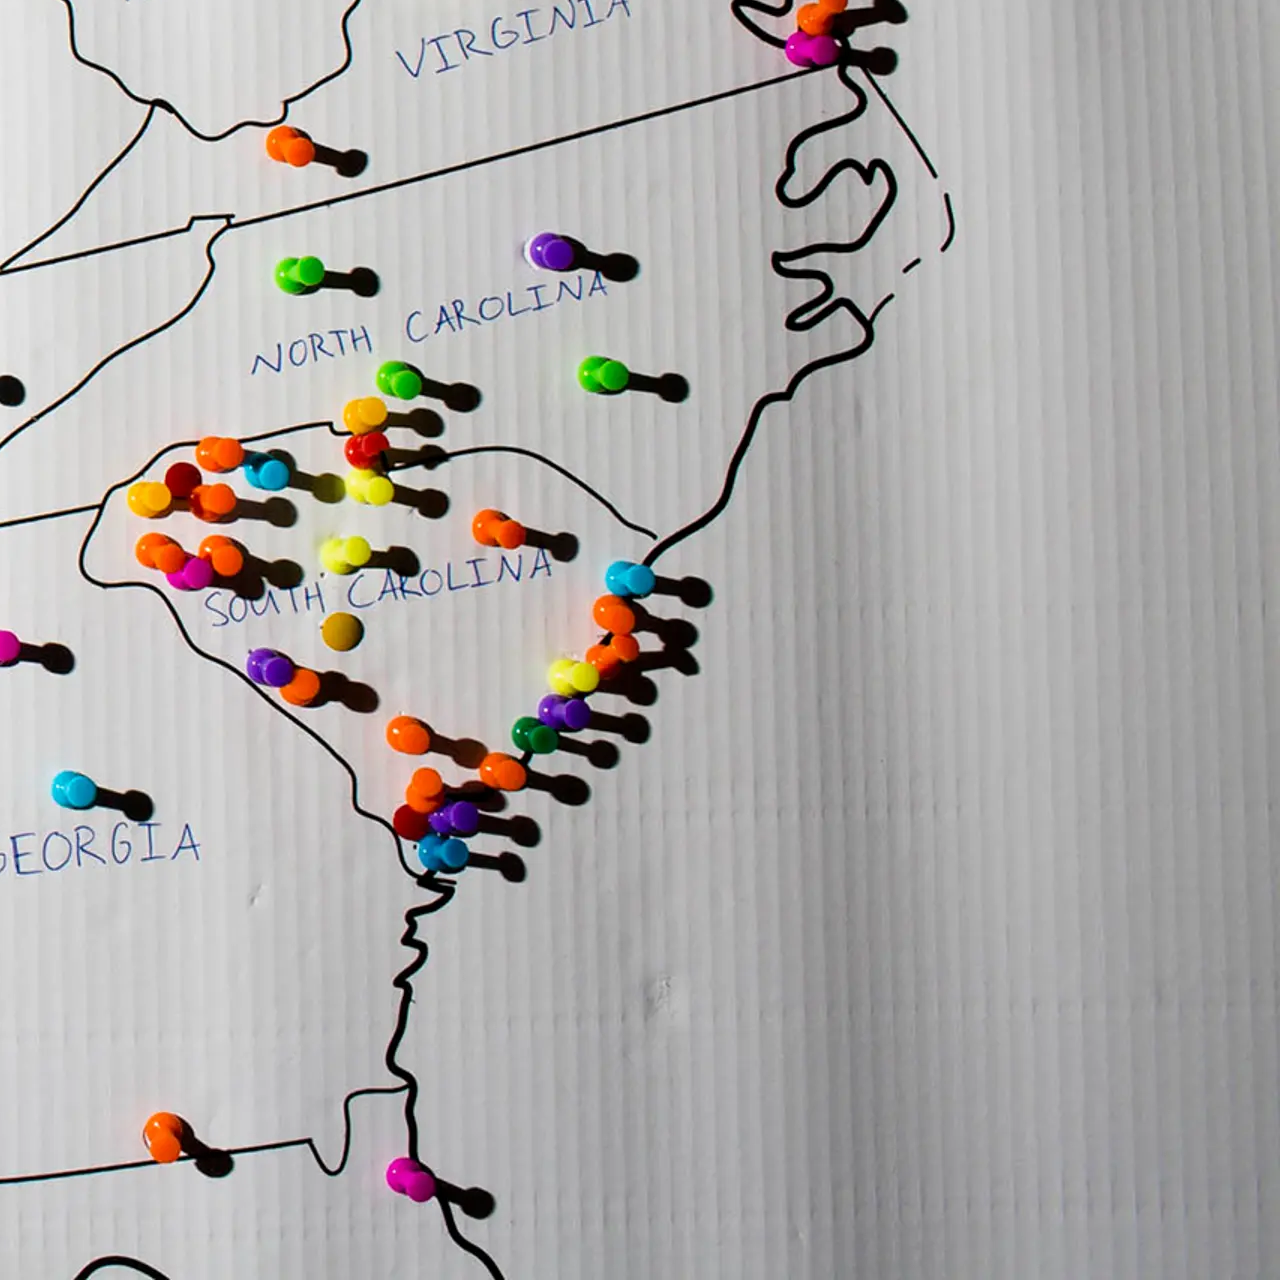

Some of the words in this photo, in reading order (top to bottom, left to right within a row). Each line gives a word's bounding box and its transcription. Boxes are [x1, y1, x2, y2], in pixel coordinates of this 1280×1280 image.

[251, 325, 372, 375] NORTH
[405, 272, 609, 344] CAROLINA
[347, 547, 554, 609] CAROLINA
